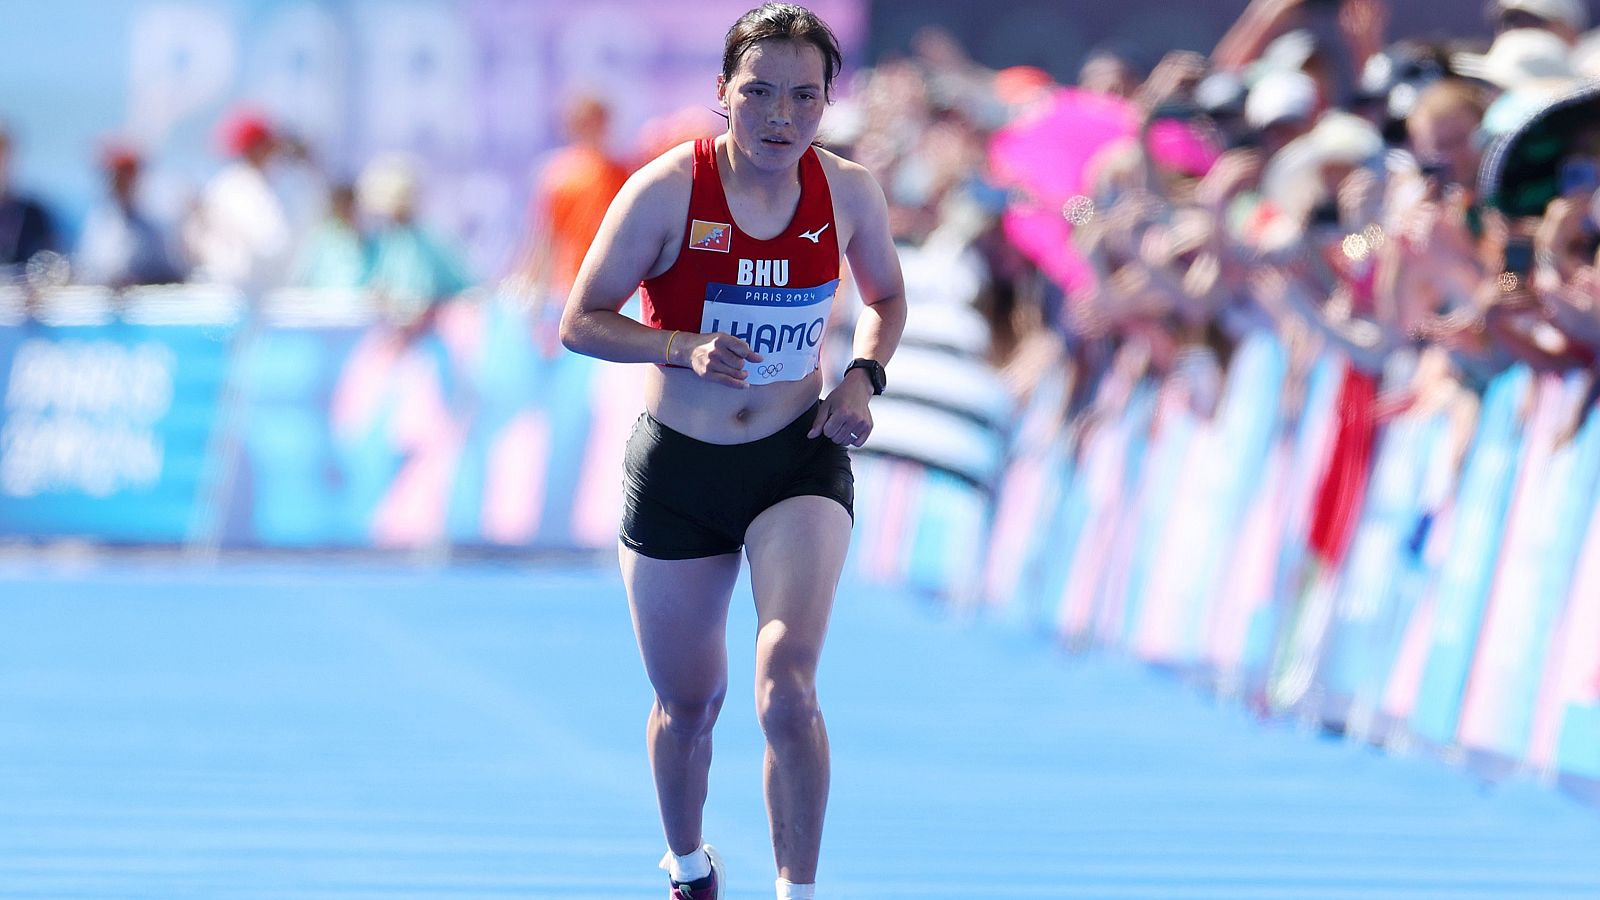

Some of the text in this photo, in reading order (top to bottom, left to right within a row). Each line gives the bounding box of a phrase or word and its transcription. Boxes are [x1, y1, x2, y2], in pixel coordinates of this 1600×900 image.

[737, 258, 789, 287] BHU
[745, 291, 816, 303] PARIS 2024
